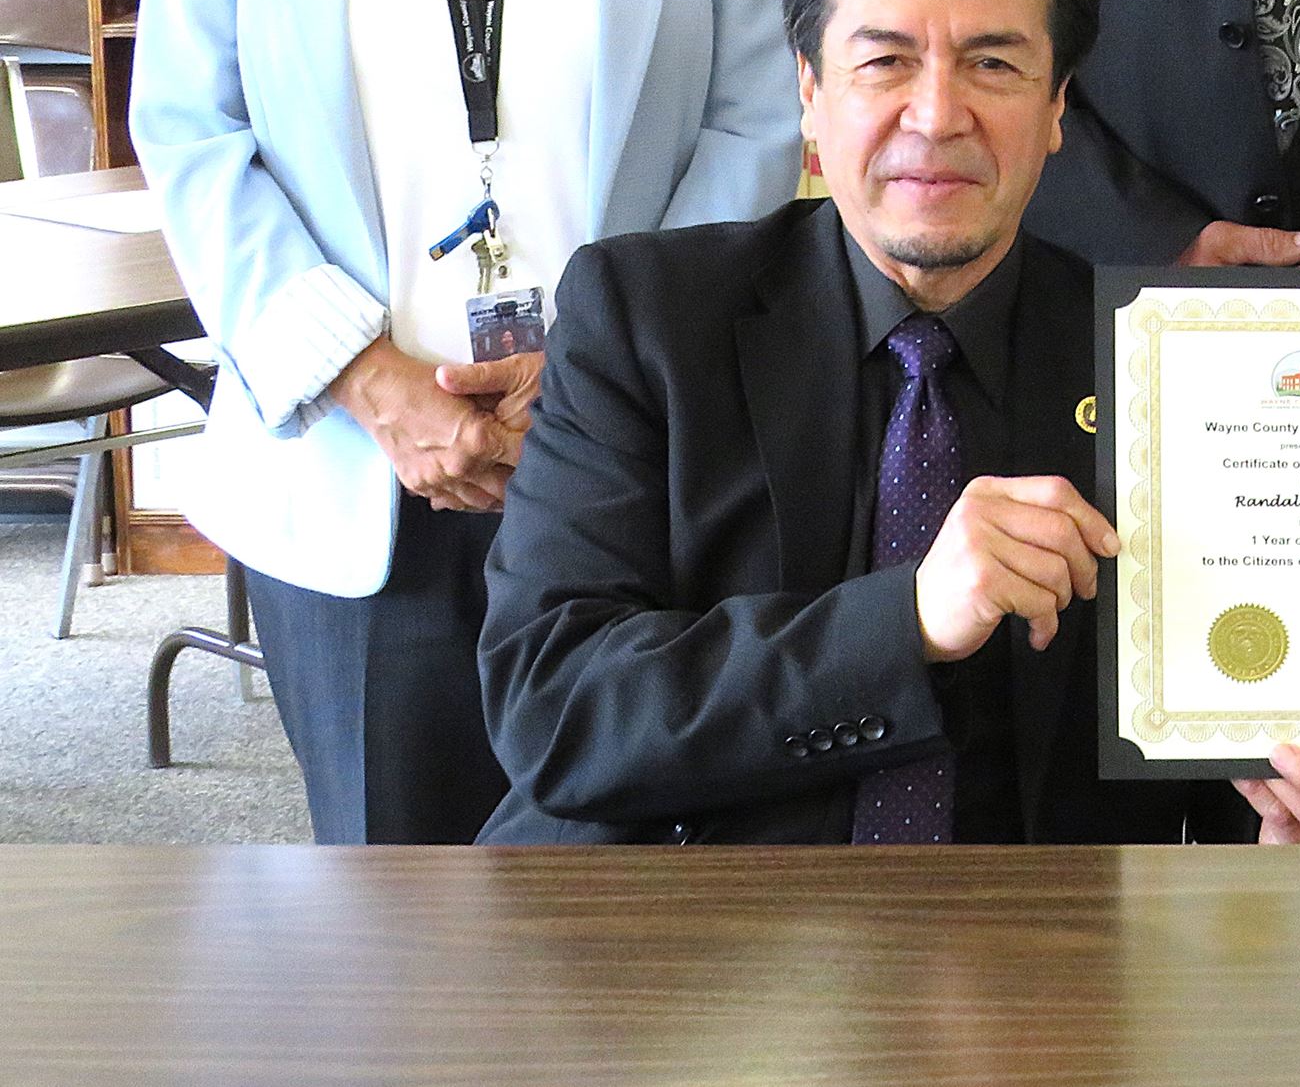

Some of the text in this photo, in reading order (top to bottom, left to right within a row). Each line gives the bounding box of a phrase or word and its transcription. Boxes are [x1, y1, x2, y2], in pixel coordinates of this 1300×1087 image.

[1205, 421, 1249, 435] Wayne
[1252, 421, 1299, 435] County
[1222, 457, 1289, 469] Certificate
[1251, 535, 1257, 546] 1
[1262, 535, 1290, 546] Year
[1202, 556, 1215, 567] to
[1218, 556, 1239, 567] the
[1242, 555, 1294, 567] Citizens
